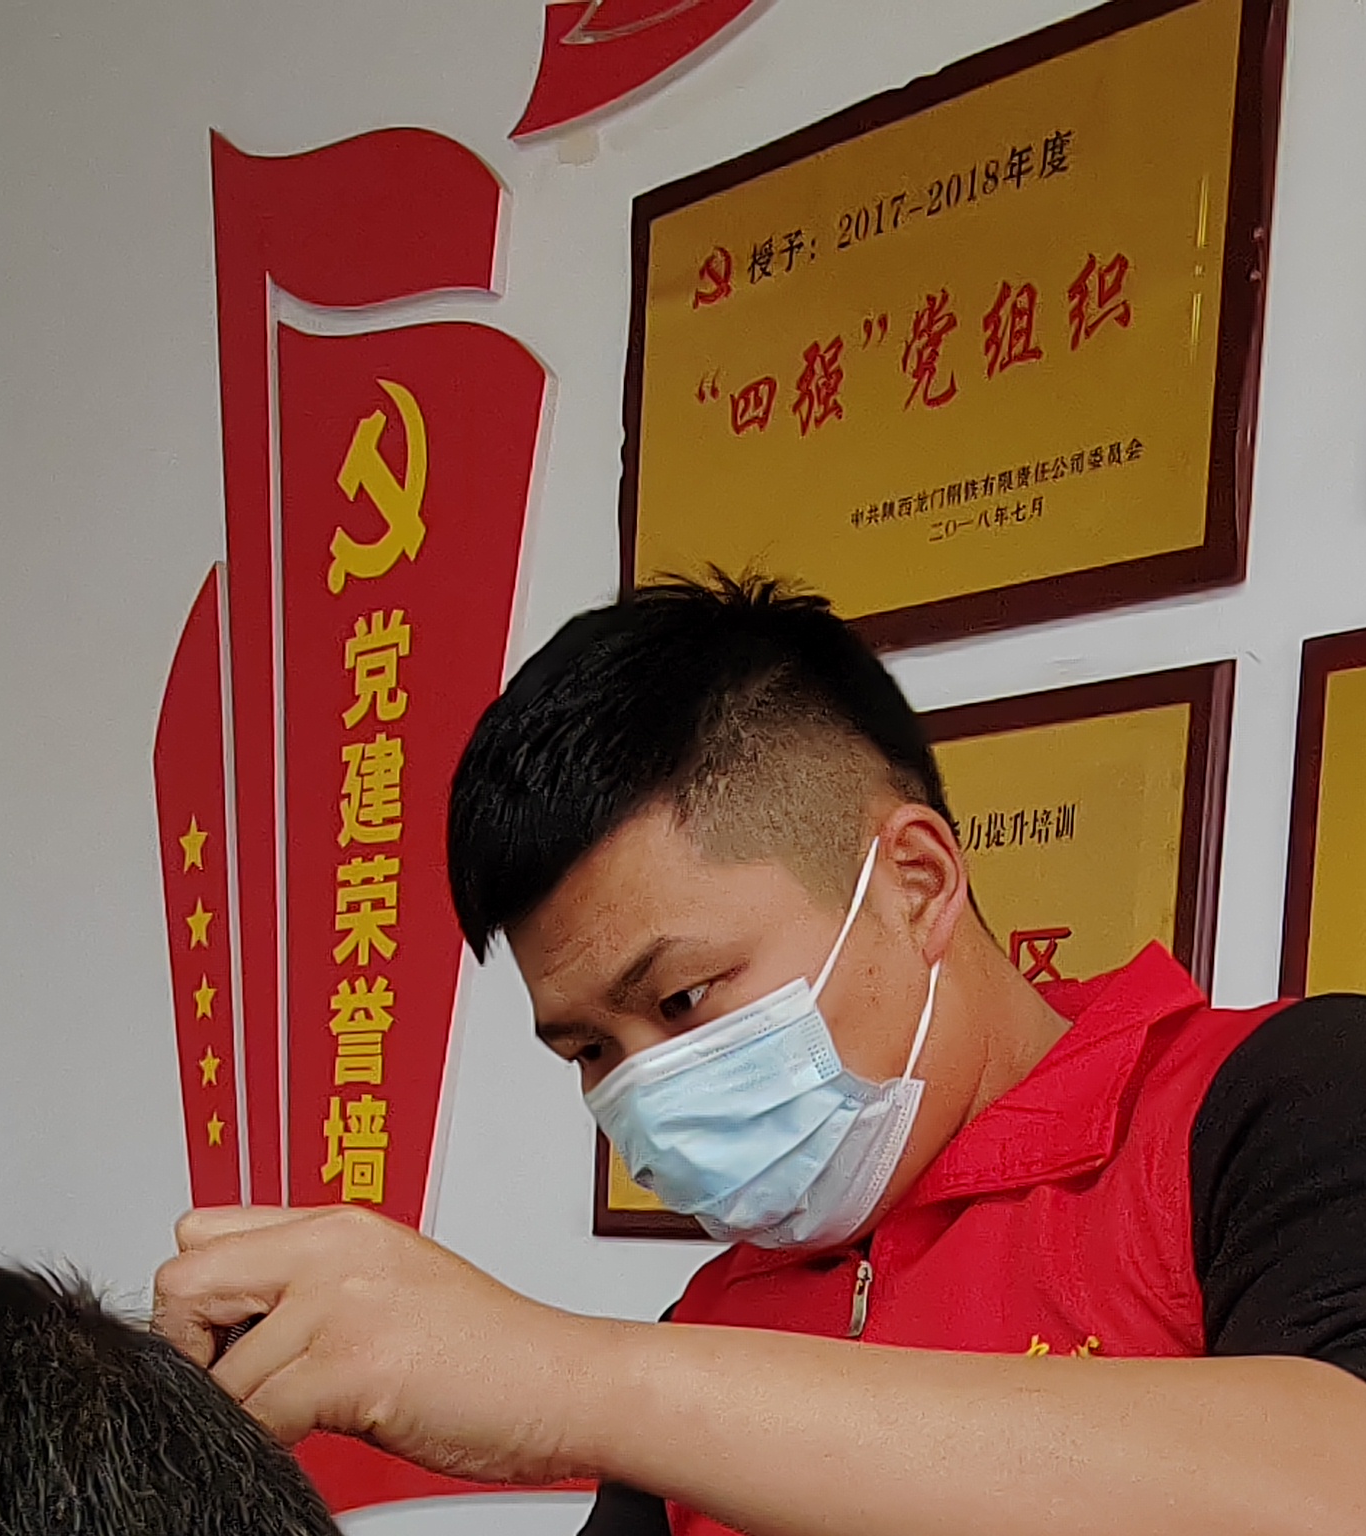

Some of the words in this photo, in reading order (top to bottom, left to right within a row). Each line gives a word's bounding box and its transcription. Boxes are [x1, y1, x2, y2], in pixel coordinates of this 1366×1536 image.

[321, 609, 412, 1204] 党建荣誉墙
[1010, 927, 1073, 981] 区
